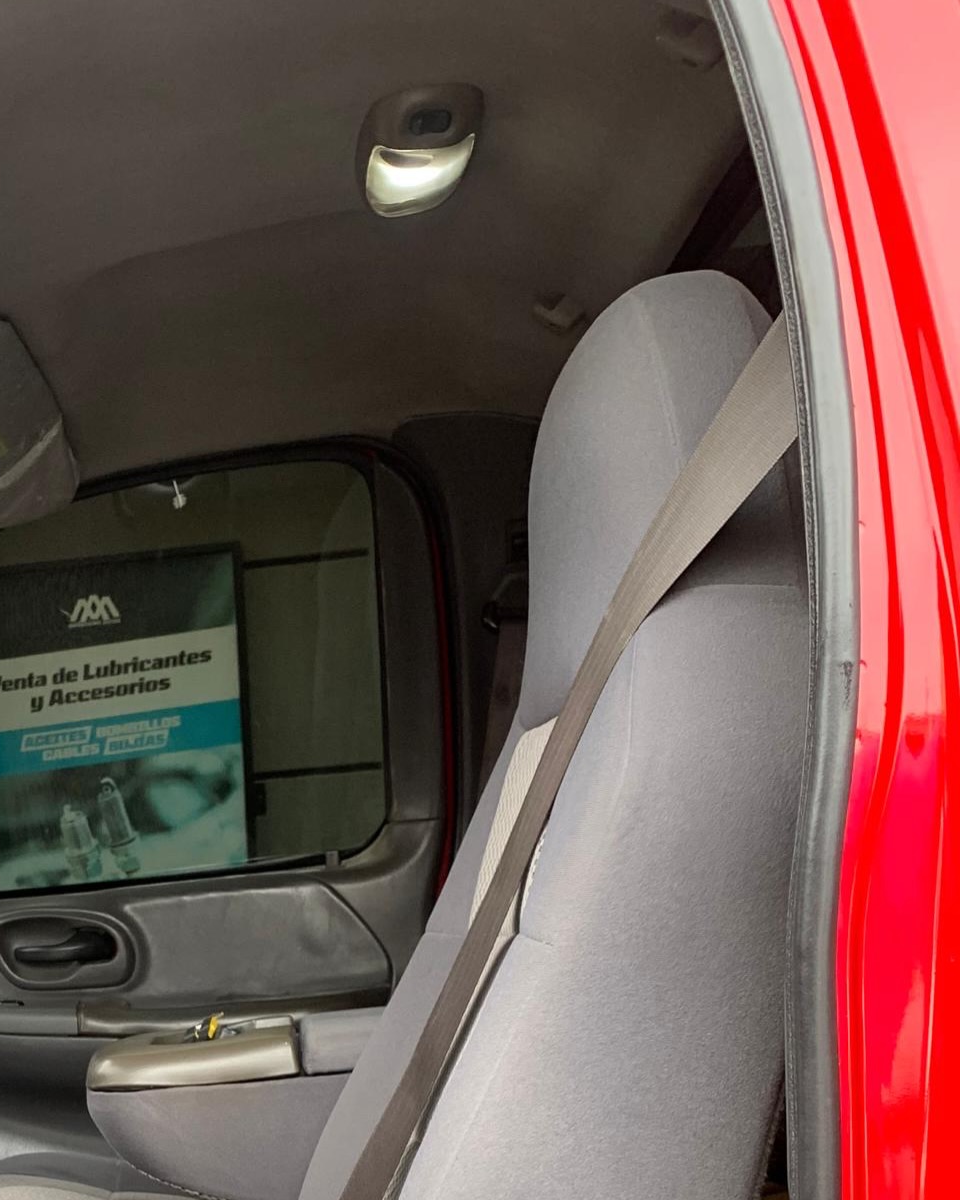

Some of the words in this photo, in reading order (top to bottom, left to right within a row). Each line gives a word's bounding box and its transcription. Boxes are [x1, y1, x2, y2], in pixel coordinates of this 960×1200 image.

[52, 667, 78, 685] de
[82, 649, 213, 681] Lubricantes
[30, 696, 44, 713] y
[48, 676, 172, 707] Accesorios
